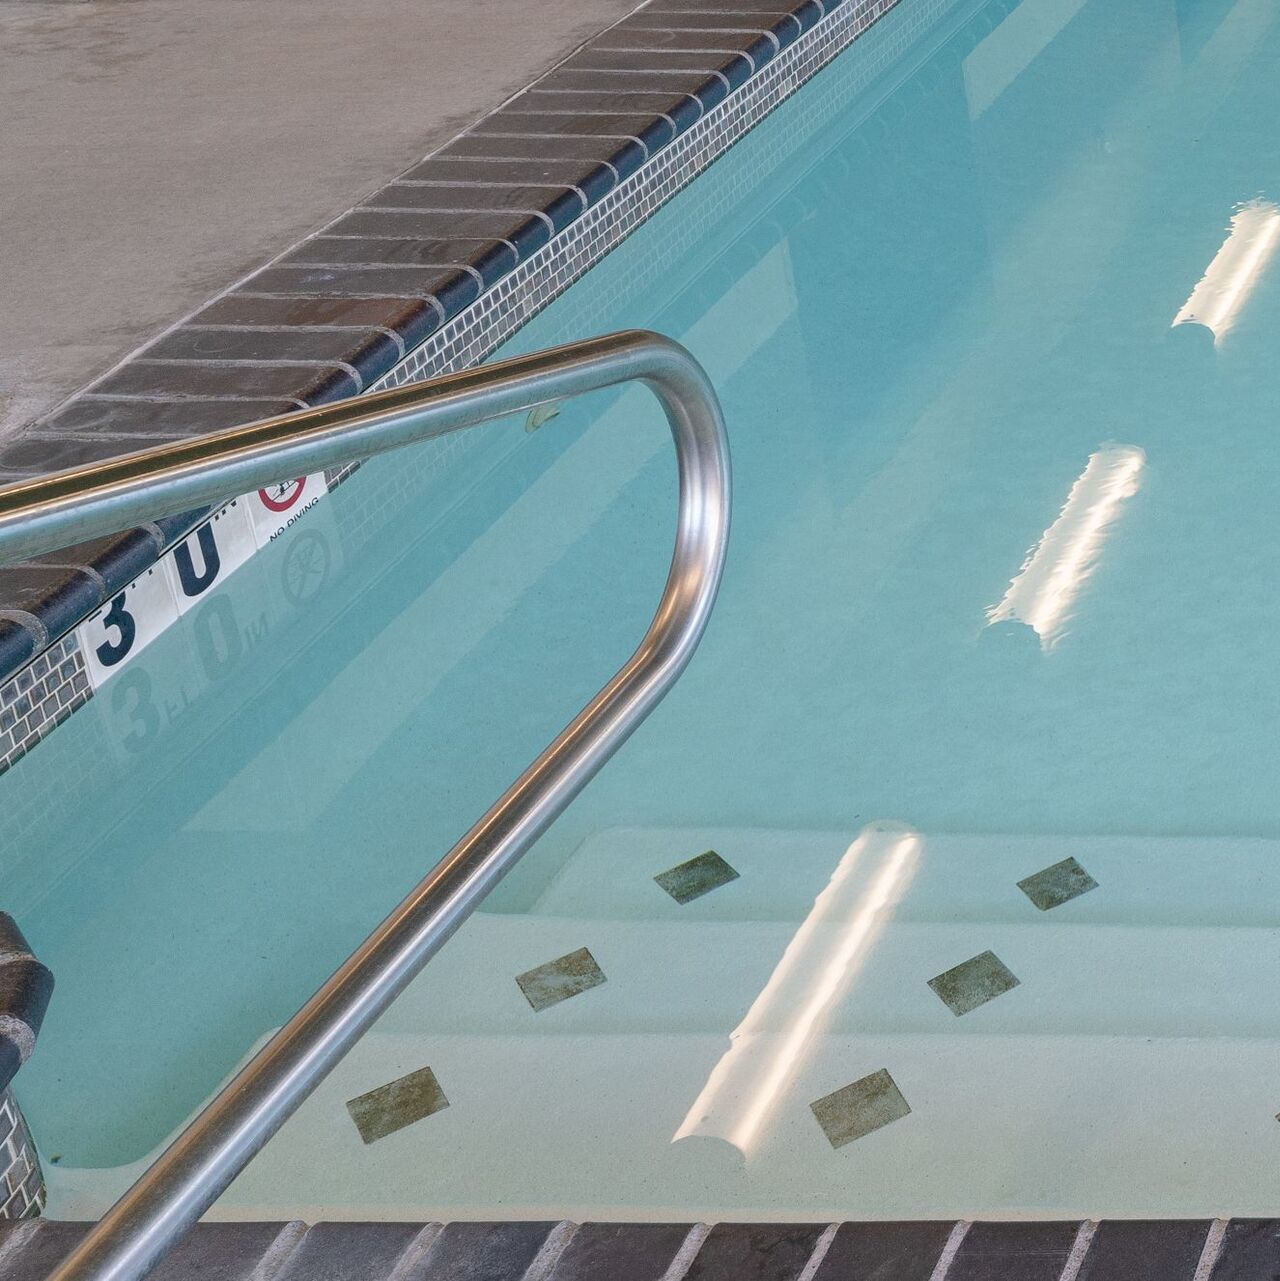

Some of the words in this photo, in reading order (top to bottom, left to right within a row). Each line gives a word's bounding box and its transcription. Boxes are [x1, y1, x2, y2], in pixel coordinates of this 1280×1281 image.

[269, 526, 285, 542] NO
[287, 496, 319, 528] DIVING
[88, 590, 136, 667] 3
